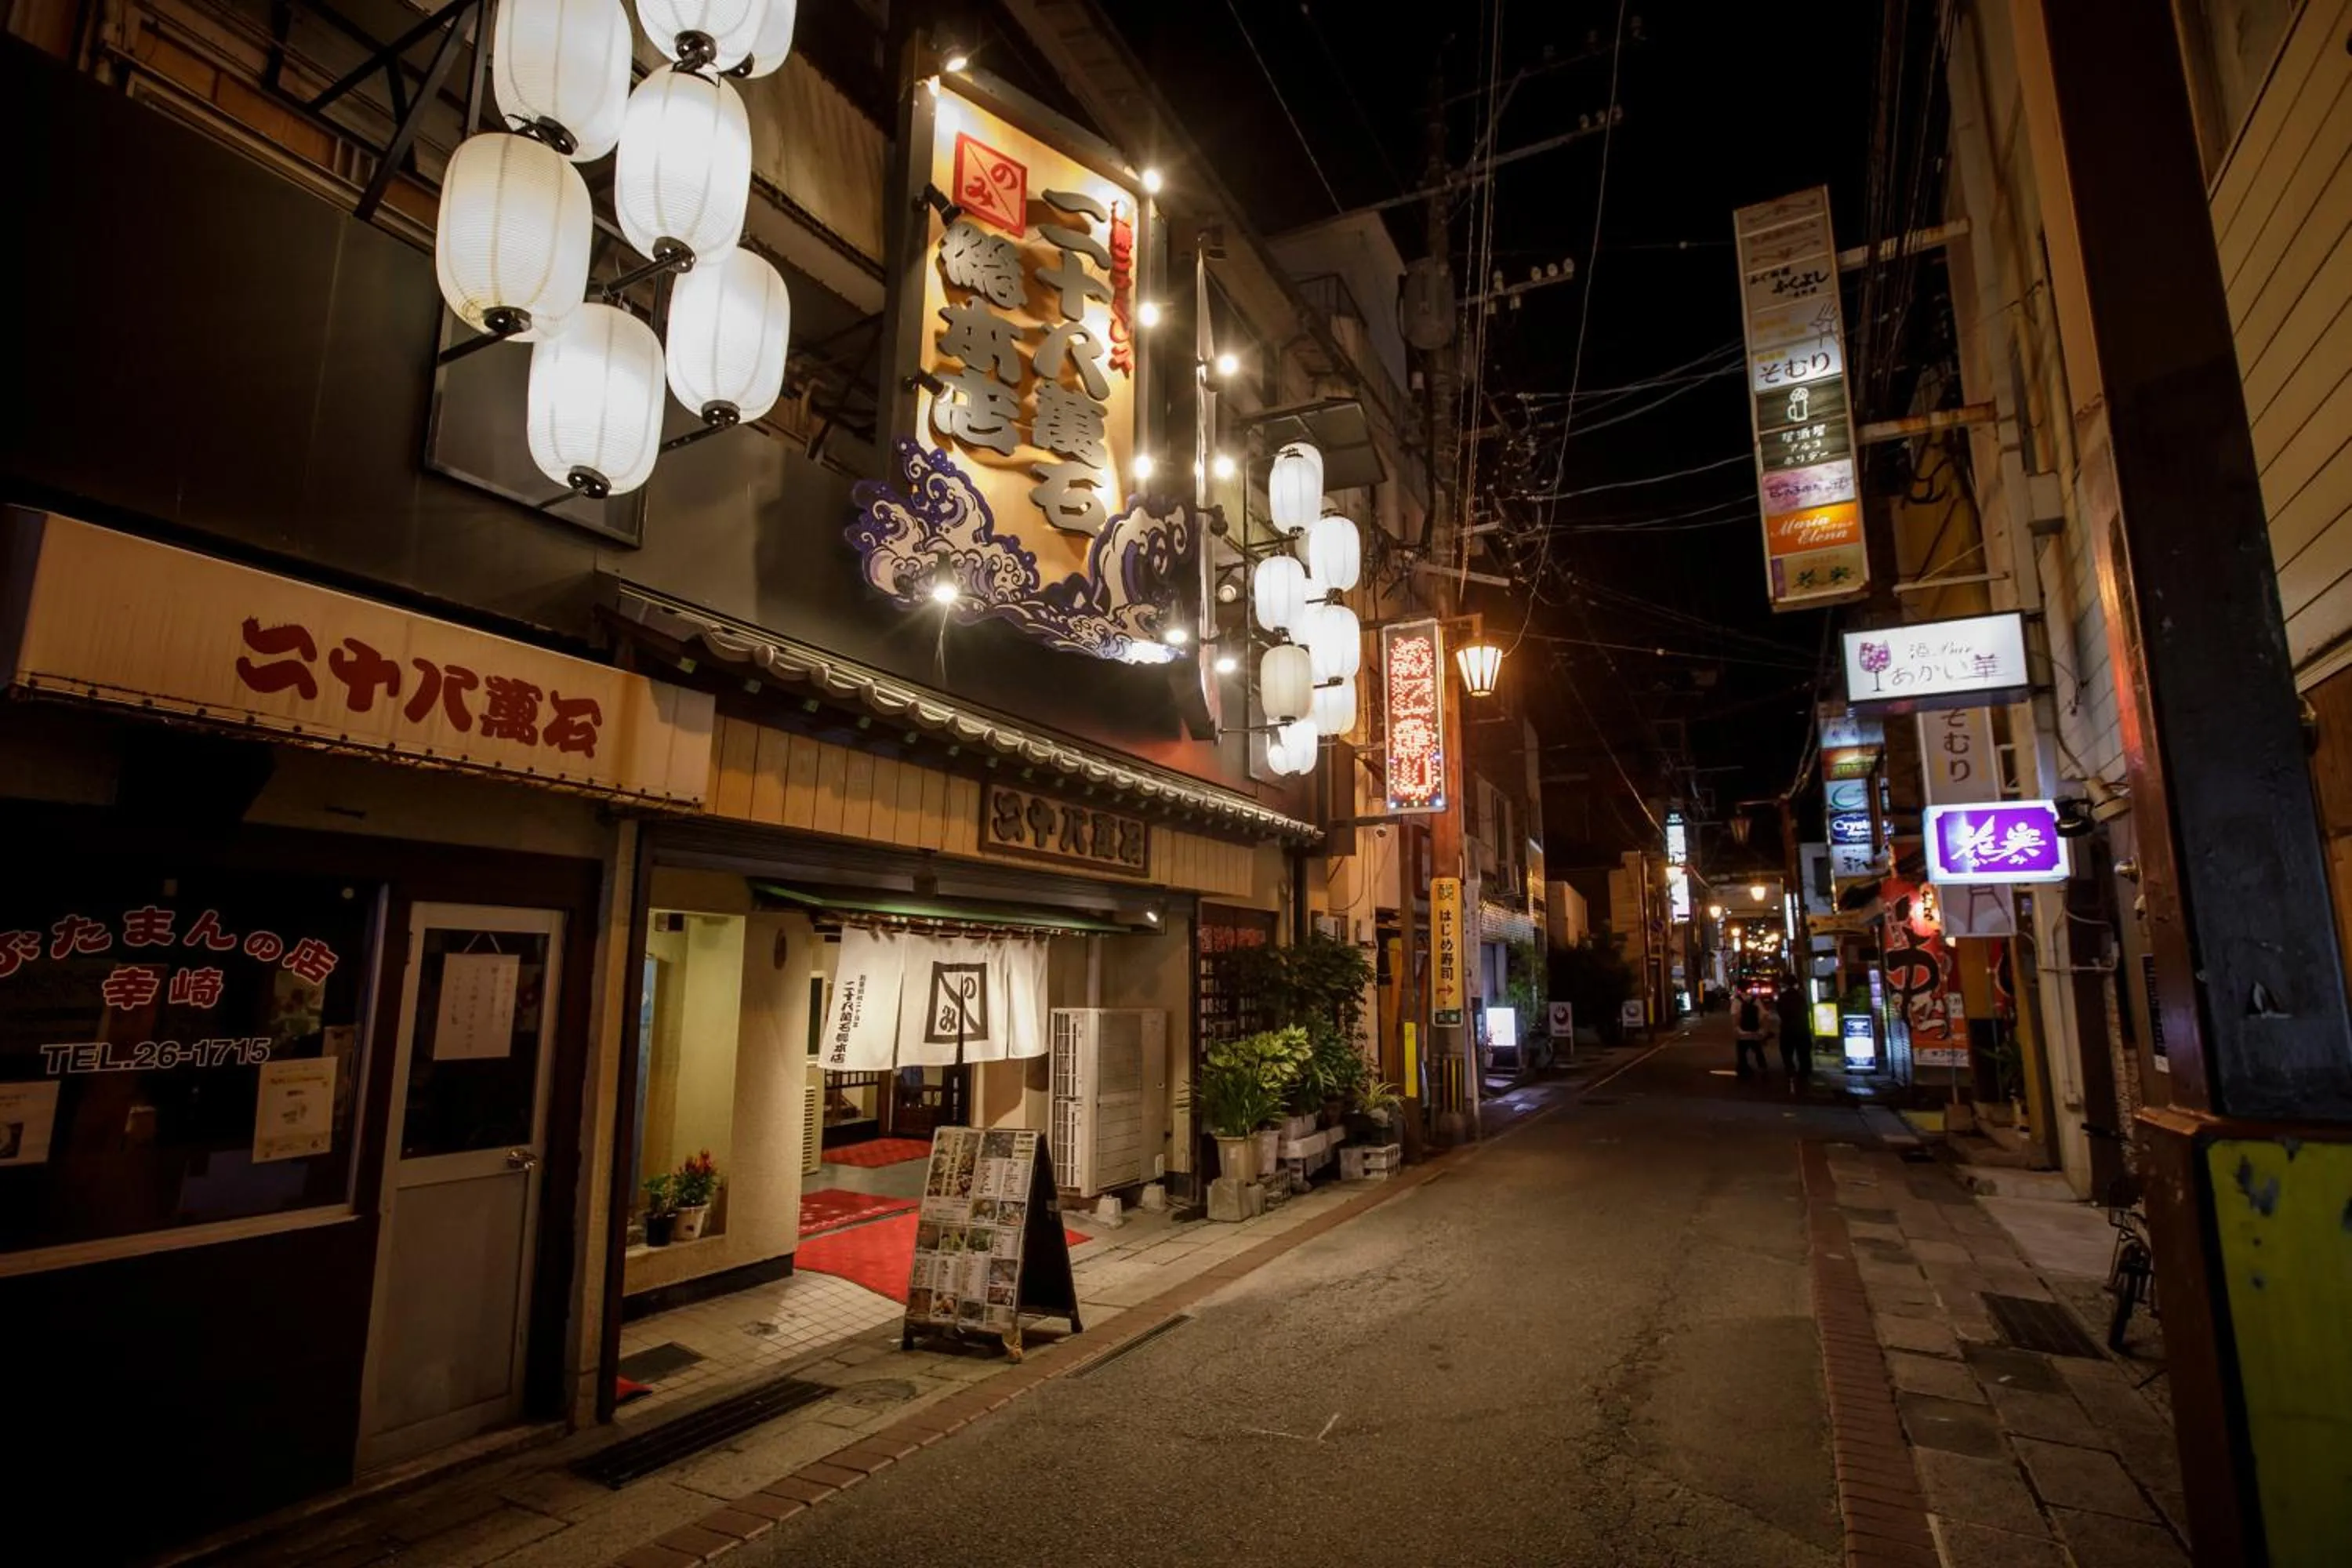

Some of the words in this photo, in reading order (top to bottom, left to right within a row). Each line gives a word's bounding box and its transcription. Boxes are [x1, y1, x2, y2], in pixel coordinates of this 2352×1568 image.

[1759, 352, 1830, 383] そむり
[236, 616, 602, 758] 二十八萬石
[1940, 708, 1970, 782] そむり
[1439, 909, 1454, 980] はじめ寿司
[102, 966, 224, 1011] 幸崎
[40, 1037, 271, 1075] TEL.26-1715
